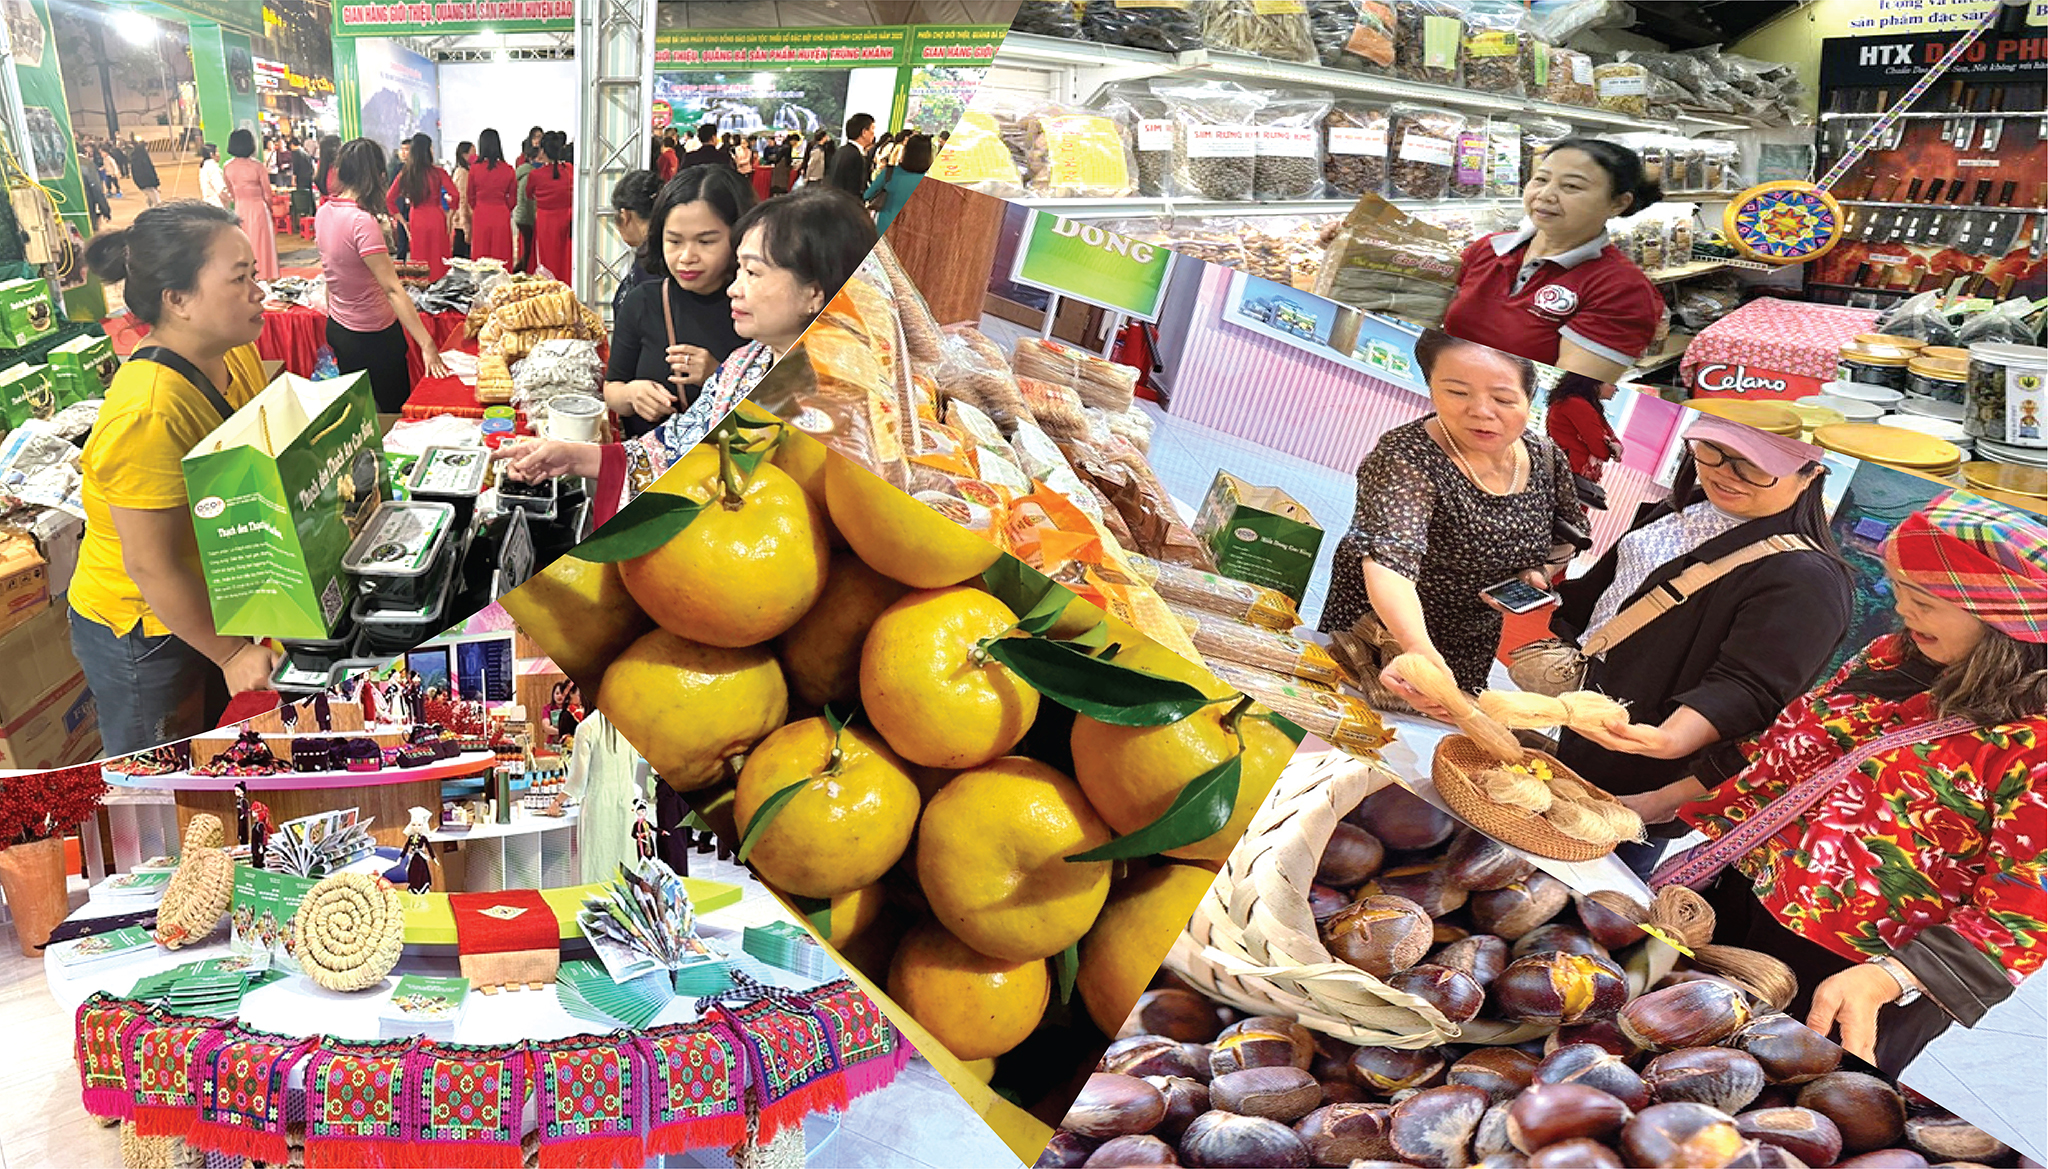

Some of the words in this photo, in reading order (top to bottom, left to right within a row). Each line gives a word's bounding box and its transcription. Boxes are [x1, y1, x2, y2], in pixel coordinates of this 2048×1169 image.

[342, 5, 363, 24] GIAN
[1859, 44, 1915, 66] HTX
[1697, 364, 1788, 392] Celano
